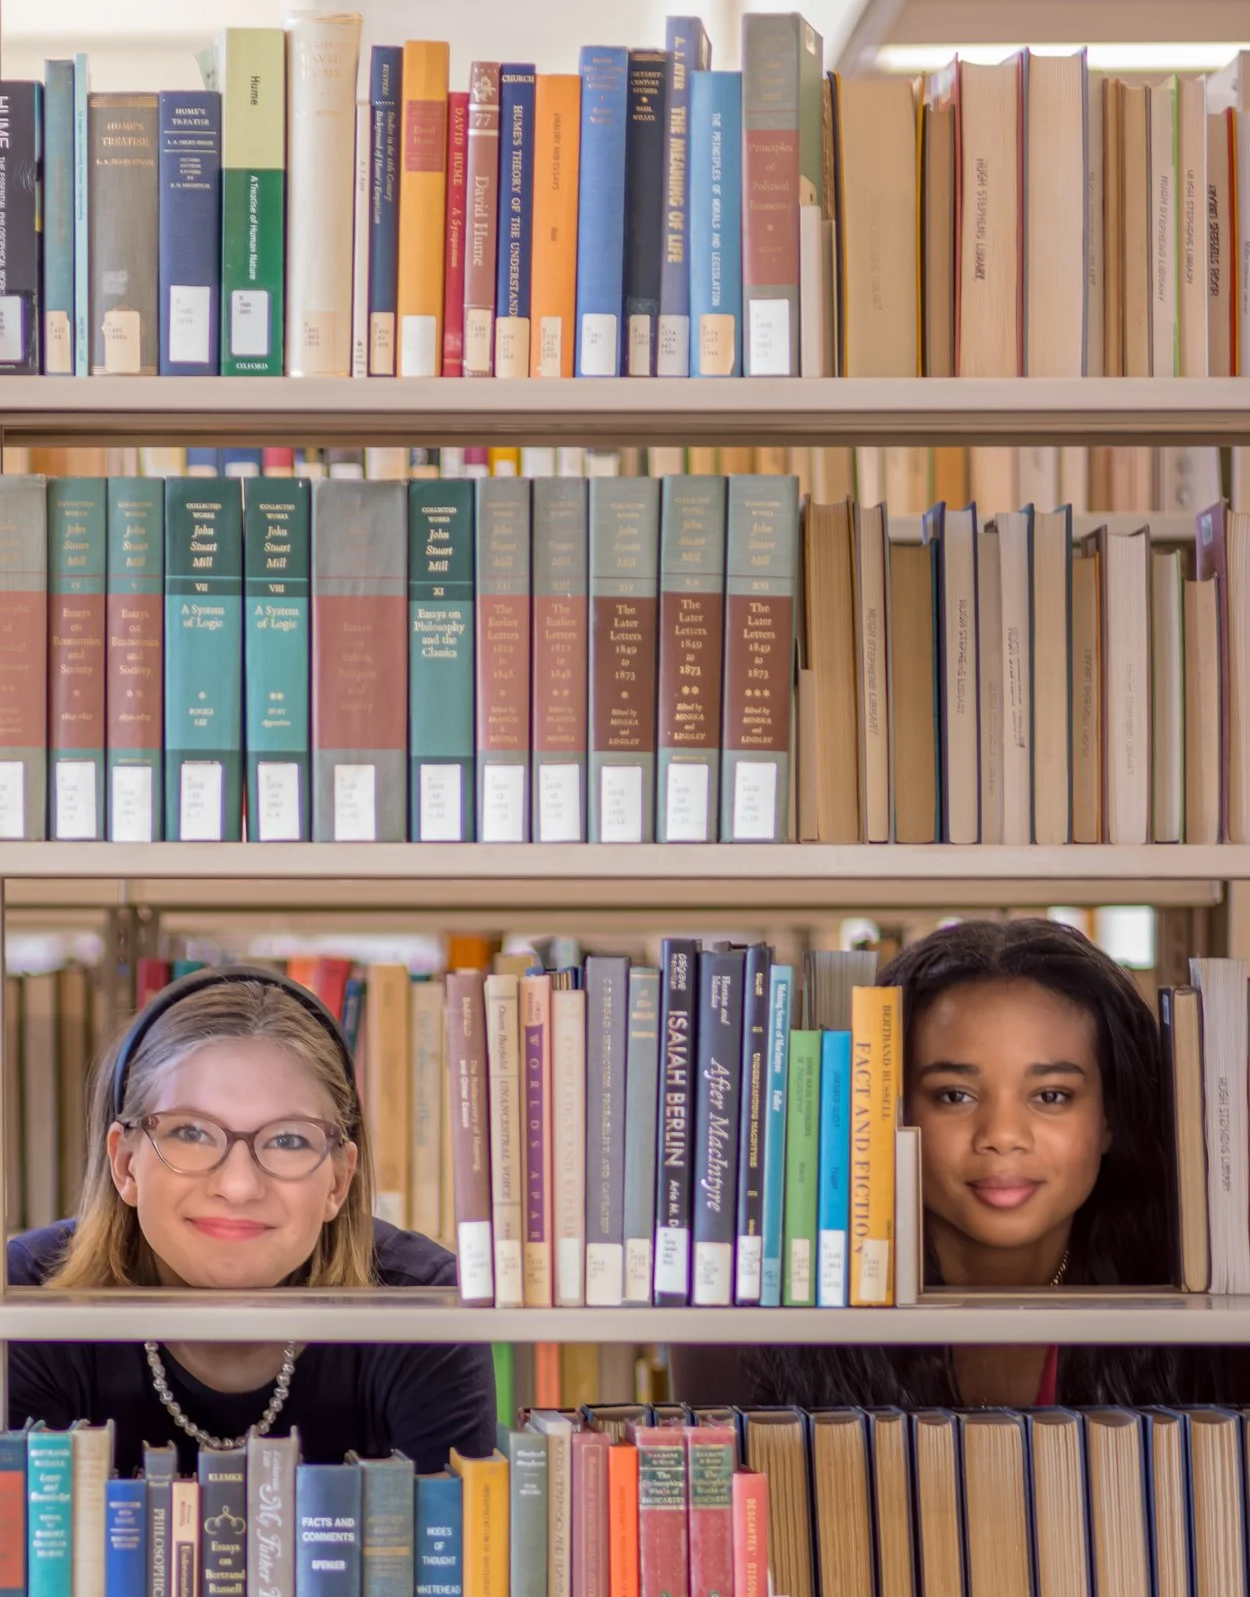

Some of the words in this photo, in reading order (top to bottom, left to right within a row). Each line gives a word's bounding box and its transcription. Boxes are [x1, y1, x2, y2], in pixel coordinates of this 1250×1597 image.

[501, 73, 535, 84] CHURCH
[673, 64, 685, 90] AYER
[250, 75, 260, 106] Hume
[474, 112, 492, 127] 77
[671, 106, 686, 133] THE
[669, 136, 686, 205] MEANING
[250, 184, 259, 216] Treatise
[476, 175, 489, 216] David
[250, 218, 258, 226] of
[668, 210, 684, 230] OF
[473, 220, 487, 267] Hume
[667, 233, 683, 264] LIFE
[191, 525, 214, 537] John
[189, 541, 218, 553] Stuart
[192, 557, 213, 568] Mill
[195, 583, 209, 593] VII
[181, 605, 190, 615] A
[192, 605, 225, 618] System
[616, 604, 637, 615] The
[183, 618, 193, 628] of
[195, 617, 223, 630] Logic
[613, 617, 639, 629] Later
[609, 629, 642, 642] Letters
[615, 644, 637, 655] 1849
[621, 656, 630, 666] to
[614, 670, 636, 681] 1873
[668, 1010, 689, 1087] ISAIAH
[855, 1041, 872, 1099] FACT
[704, 1057, 731, 1108] After
[664, 1092, 687, 1168] BERLIN
[854, 1104, 871, 1152] AND
[700, 1111, 731, 1214] MacIntyre
[854, 1159, 872, 1254] FICTION
[301, 1517, 332, 1528] FACTS
[333, 1517, 355, 1528] AND
[302, 1531, 355, 1543] COMMENTS
[426, 1526, 452, 1538] MODES
[211, 1542, 240, 1554] Essays
[433, 1541, 446, 1551] OF
[219, 1558, 232, 1566] on
[422, 1555, 457, 1566] THOUGHT
[205, 1569, 246, 1581] Bertrand
[208, 1583, 242, 1594] Russell
[416, 1584, 461, 1596] WHITEHEAD
